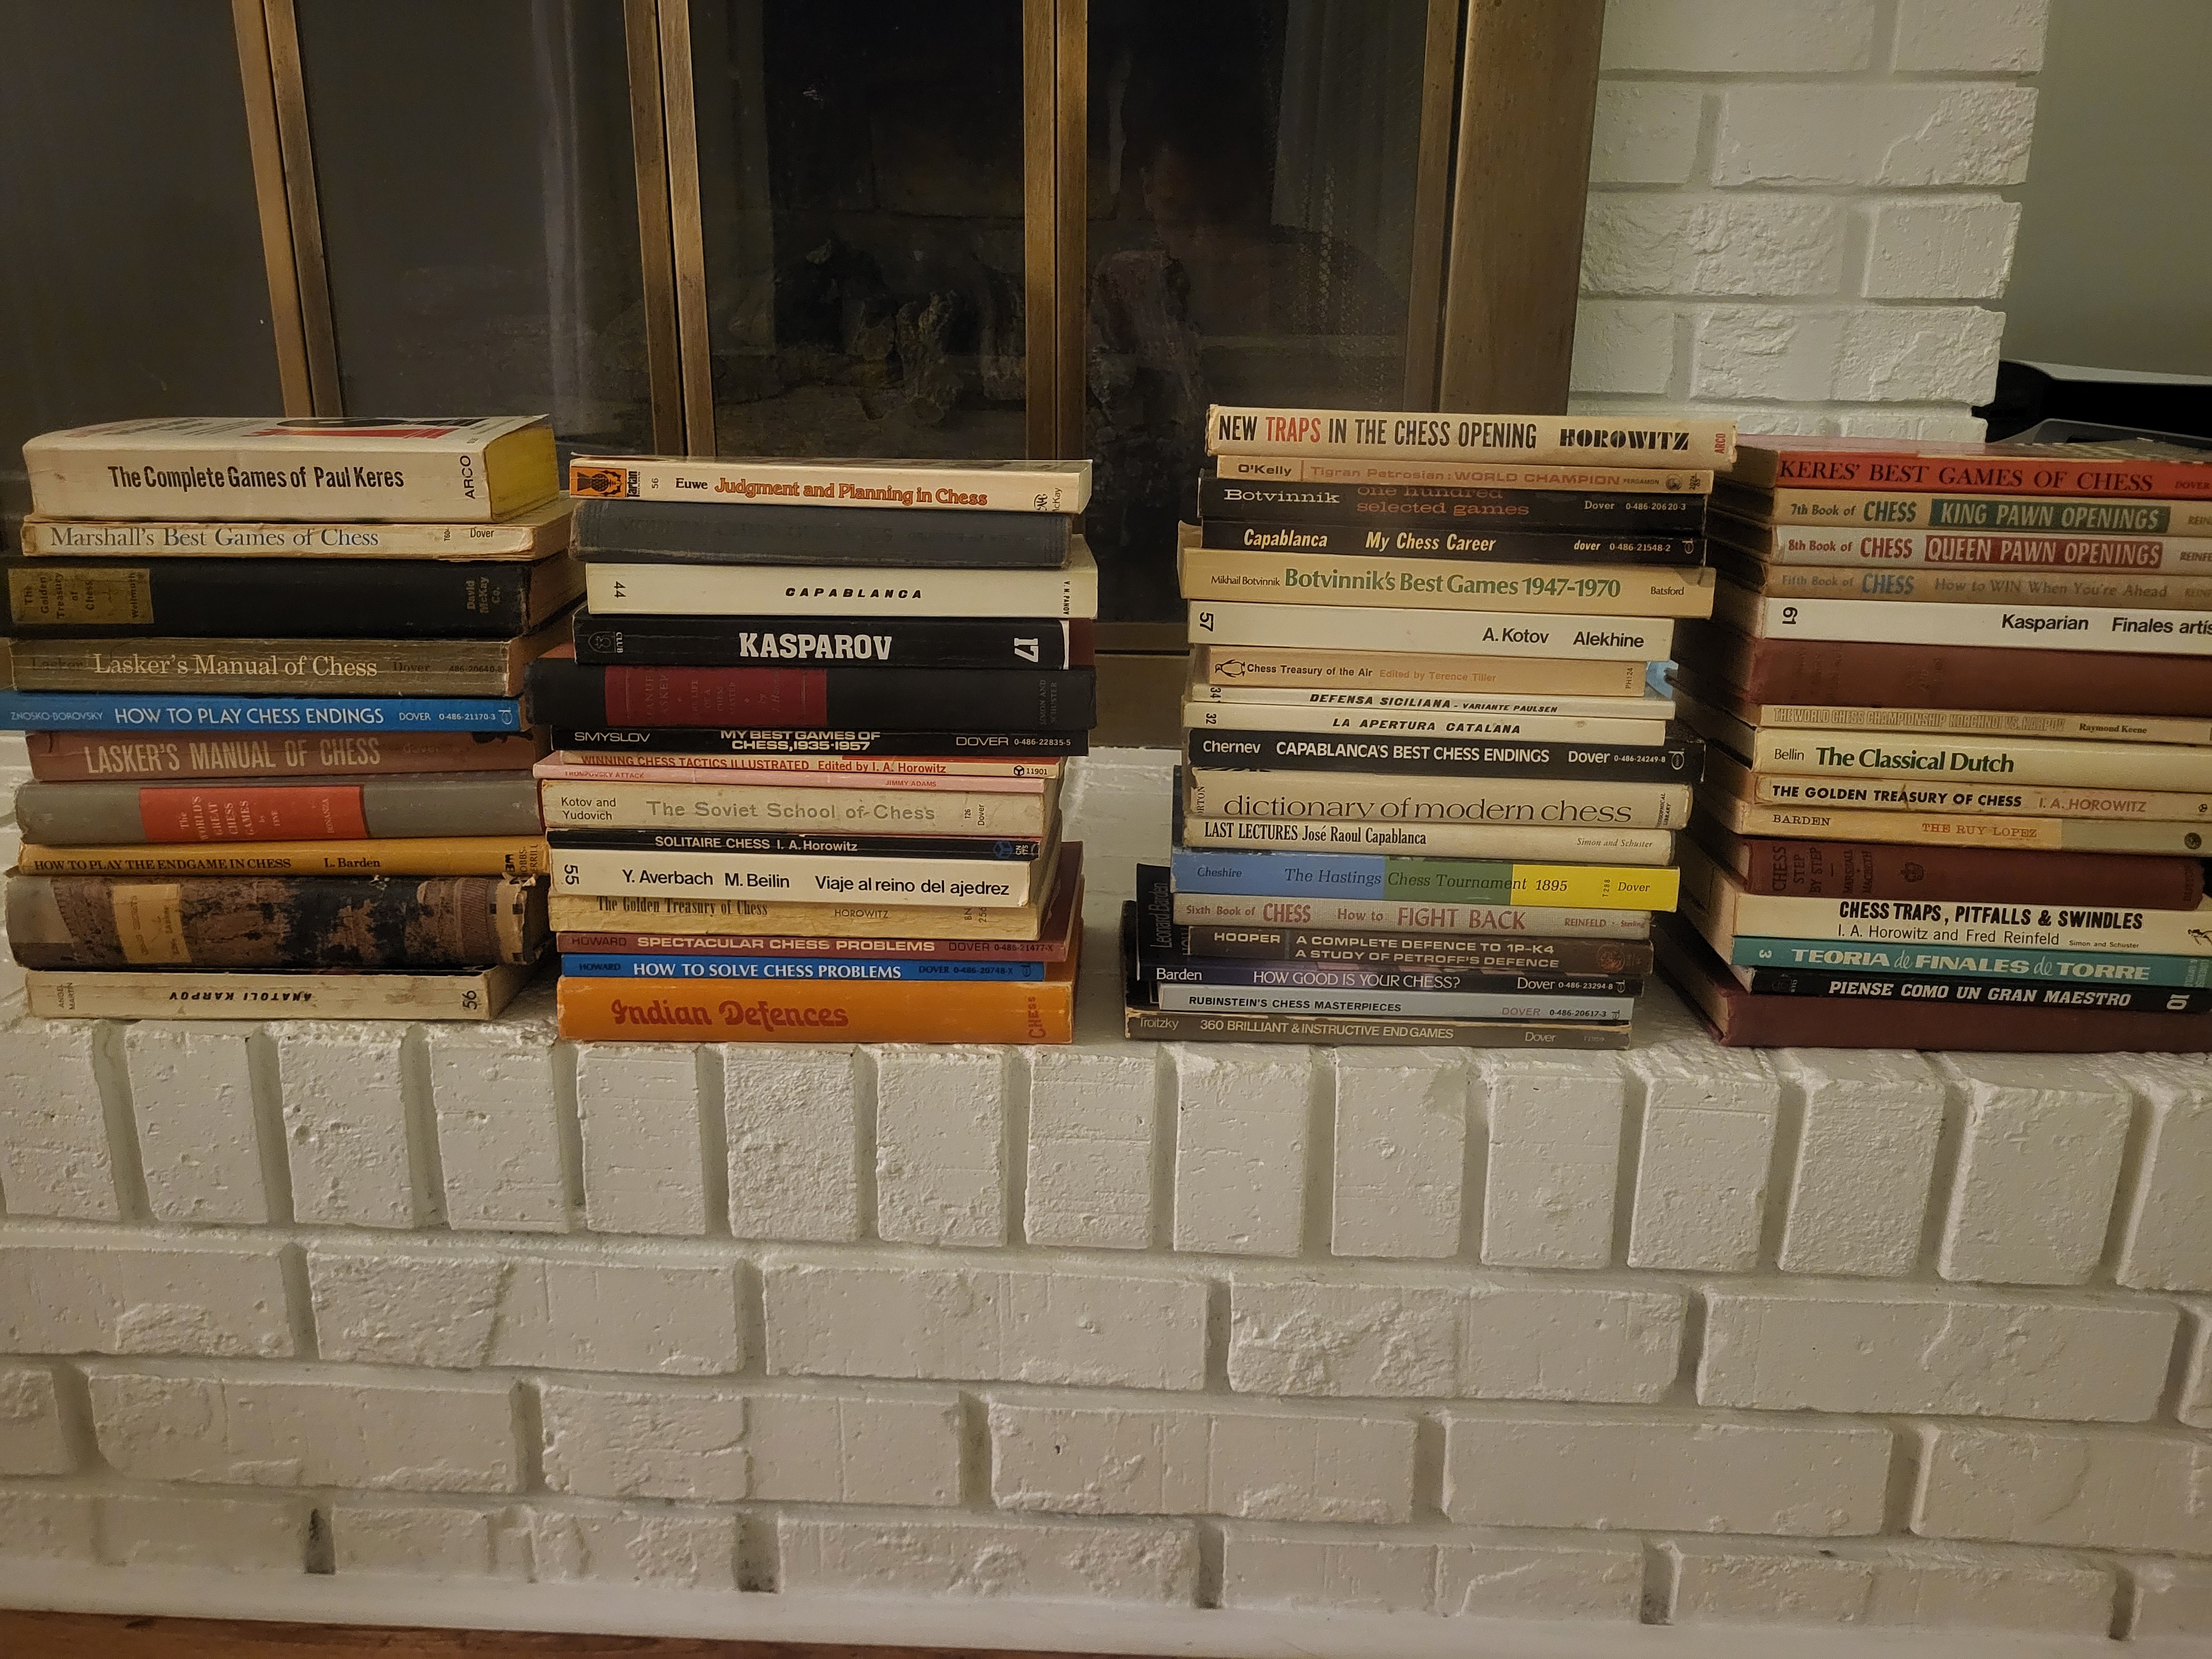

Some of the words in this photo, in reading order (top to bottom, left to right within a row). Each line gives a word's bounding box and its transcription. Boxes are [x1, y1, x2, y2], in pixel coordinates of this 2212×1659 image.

[1219, 416, 1258, 441] NEW
[1265, 416, 1321, 442] TRAPS
[1328, 418, 1348, 444] IN
[1355, 419, 1387, 445] THE
[1394, 420, 1451, 447] CHESS
[1458, 421, 1537, 449] OPENING
[1559, 429, 1689, 450] HOROWITZ
[1714, 433, 1726, 453] ARCO
[108, 466, 142, 488] The
[144, 467, 225, 492] Complete
[228, 467, 287, 488] Games
[291, 467, 306, 487] of
[314, 467, 351, 488] Paul
[355, 467, 404, 488] Keres
[460, 455, 476, 499] ARCO
[1238, 463, 1292, 477] O'Kelly
[1779, 460, 1860, 481] KERES'
[1869, 464, 1929, 482] BEST
[1938, 466, 2023, 487] GAMES
[2034, 470, 2067, 488] OF
[2077, 472, 2153, 492] CHESS
[676, 478, 708, 490] Euwe
[714, 478, 800, 498] Judgment
[803, 481, 834, 498] and
[839, 483, 913, 506] Planning
[917, 487, 932, 503] in
[936, 488, 988, 505] Chess
[1224, 489, 1340, 504] Botvinnik
[1584, 500, 1615, 510] Dover
[1626, 502, 1686, 511] 0-486-20620-3
[51, 527, 155, 546] Marshall's
[165, 528, 206, 546] Best
[215, 527, 285, 546] Games
[293, 529, 313, 546] of
[321, 529, 378, 546] Chess
[470, 528, 494, 538] Dover
[614, 581, 627, 598] 44
[1285, 568, 1396, 591] Botvinnik's
[1400, 573, 1444, 592] Best
[1446, 575, 1518, 595] Games
[1522, 577, 1621, 597] 1947-1970
[1650, 586, 1684, 596] Batsford
[785, 587, 922, 599] CAPABLANCA
[1199, 612, 1214, 632] 57
[1782, 607, 1798, 625] 61
[2001, 614, 2089, 633] Kasparian
[2112, 617, 2173, 634] Finales
[739, 633, 892, 660] KASPAROV
[1482, 627, 1499, 642] A.
[1502, 628, 1550, 644] Kotov
[1573, 631, 1644, 648] Alekhine
[1014, 638, 1039, 662] 17
[93, 653, 187, 675] Lasker's
[194, 654, 279, 675] Manual
[285, 656, 306, 676] of
[312, 656, 378, 677] Chess
[115, 708, 160, 724] HOW
[168, 708, 192, 724] TO
[199, 708, 242, 724] PLAY
[247, 708, 300, 724] CHESS
[306, 708, 384, 724] ENDINGS
[399, 712, 431, 721] DOVER
[574, 732, 650, 743] SMYSLOV
[956, 737, 1009, 746] DOVER
[84, 742, 180, 774] LASKER'S
[189, 740, 276, 770] MANUAL
[285, 739, 307, 767] OF
[320, 737, 381, 767] CHESS
[1203, 740, 1261, 754] Chernev
[1276, 741, 1389, 759] CAPABLANCA'S
[1393, 745, 1430, 760] BEST
[1433, 747, 1480, 761] CHESS
[1484, 748, 1550, 763] ENDINGS
[1568, 750, 1610, 763] Dover
[1774, 748, 1804, 761] Bellin
[1816, 747, 1855, 766] The
[1859, 748, 1945, 770] Classical
[1950, 752, 2014, 773] Dutch
[581, 755, 635, 766] WINNING
[638, 757, 675, 767] CHESS
[679, 758, 727, 769] TACTICS
[731, 759, 809, 770] ILLUSTRATED
[818, 761, 852, 771] Edited
[856, 761, 868, 773] by
[873, 761, 879, 771] I.
[883, 763, 894, 772] A.
[898, 763, 946, 773] Horowitz
[561, 796, 592, 807] Kotov
[596, 797, 616, 807] and
[1772, 785, 1798, 797] THE
[1805, 787, 1867, 800] GOLDEN
[1874, 790, 1948, 804] TREASURY
[1953, 793, 1973, 805] OF
[1978, 794, 2021, 807] CHESS
[562, 810, 612, 820] Yudovich
[1224, 795, 1375, 819] dictionary
[1380, 797, 1411, 818] of
[1415, 798, 1535, 820] modern
[1541, 800, 1632, 823] chess
[1772, 814, 1830, 826] BARDEN
[1205, 822, 1235, 838] LAST
[1238, 823, 1298, 840] LECTURES
[1302, 825, 1327, 841] José
[1330, 827, 1361, 843] Raoul
[1365, 828, 1427, 846] Capablanca
[34, 860, 65, 870] HOW
[69, 860, 87, 870] TO
[89, 860, 123, 870] PLAY
[126, 859, 155, 870] THE
[159, 859, 227, 869] ENDGAME
[230, 859, 245, 869] IN
[247, 858, 291, 868] CHESS
[324, 858, 335, 868] L.
[338, 857, 380, 868] Barden
[564, 864, 580, 885] 55
[622, 869, 635, 883] Y.
[640, 869, 713, 885] Averbach
[724, 873, 743, 886] M.
[747, 873, 790, 888] Beilin
[815, 875, 854, 893] Viaje
[858, 877, 873, 891] al
[875, 878, 915, 893] reino
[921, 879, 945, 894] del
[950, 881, 1010, 897] ajedrez
[1285, 868, 1313, 883] The
[1318, 869, 1382, 886] Hastings
[1387, 872, 1431, 886] Chess
[1437, 874, 1527, 890] Tournament
[1535, 879, 1568, 892] 1895
[1618, 881, 1650, 893] Dover
[1840, 901, 1890, 920] CHESS
[1955, 906, 2031, 926] PITFALLS
[2038, 910, 2052, 926] &
[2058, 910, 2143, 929] SWINDLES
[1838, 924, 1845, 936] I.
[1850, 925, 1863, 938] A.
[1869, 925, 1928, 940] Horowitz
[1933, 928, 1959, 941] and
[1966, 929, 1996, 942] Fred
[2004, 931, 2060, 946] Reinfeld
[1791, 948, 1890, 967] TEORIA
[1895, 950, 1913, 969] de
[1915, 954, 2030, 974] FINALES
[2033, 956, 2054, 975] de
[2057, 962, 2151, 980] TORRE
[169, 991, 234, 1001] KARPOV
[244, 992, 311, 1001] ANATOLI
[462, 989, 477, 1010] 56
[1829, 980, 1894, 995] PIENSE
[1901, 984, 1948, 999] COMO
[1956, 986, 1982, 1000] UN
[1988, 988, 2037, 1003] GRAN
[2043, 990, 2131, 1006] MAESTRO
[1189, 996, 1267, 1008] RUBINSTEIN'S
[1272, 999, 1311, 1009] CHESS
[1314, 1000, 1401, 1013] MASTERPIECES
